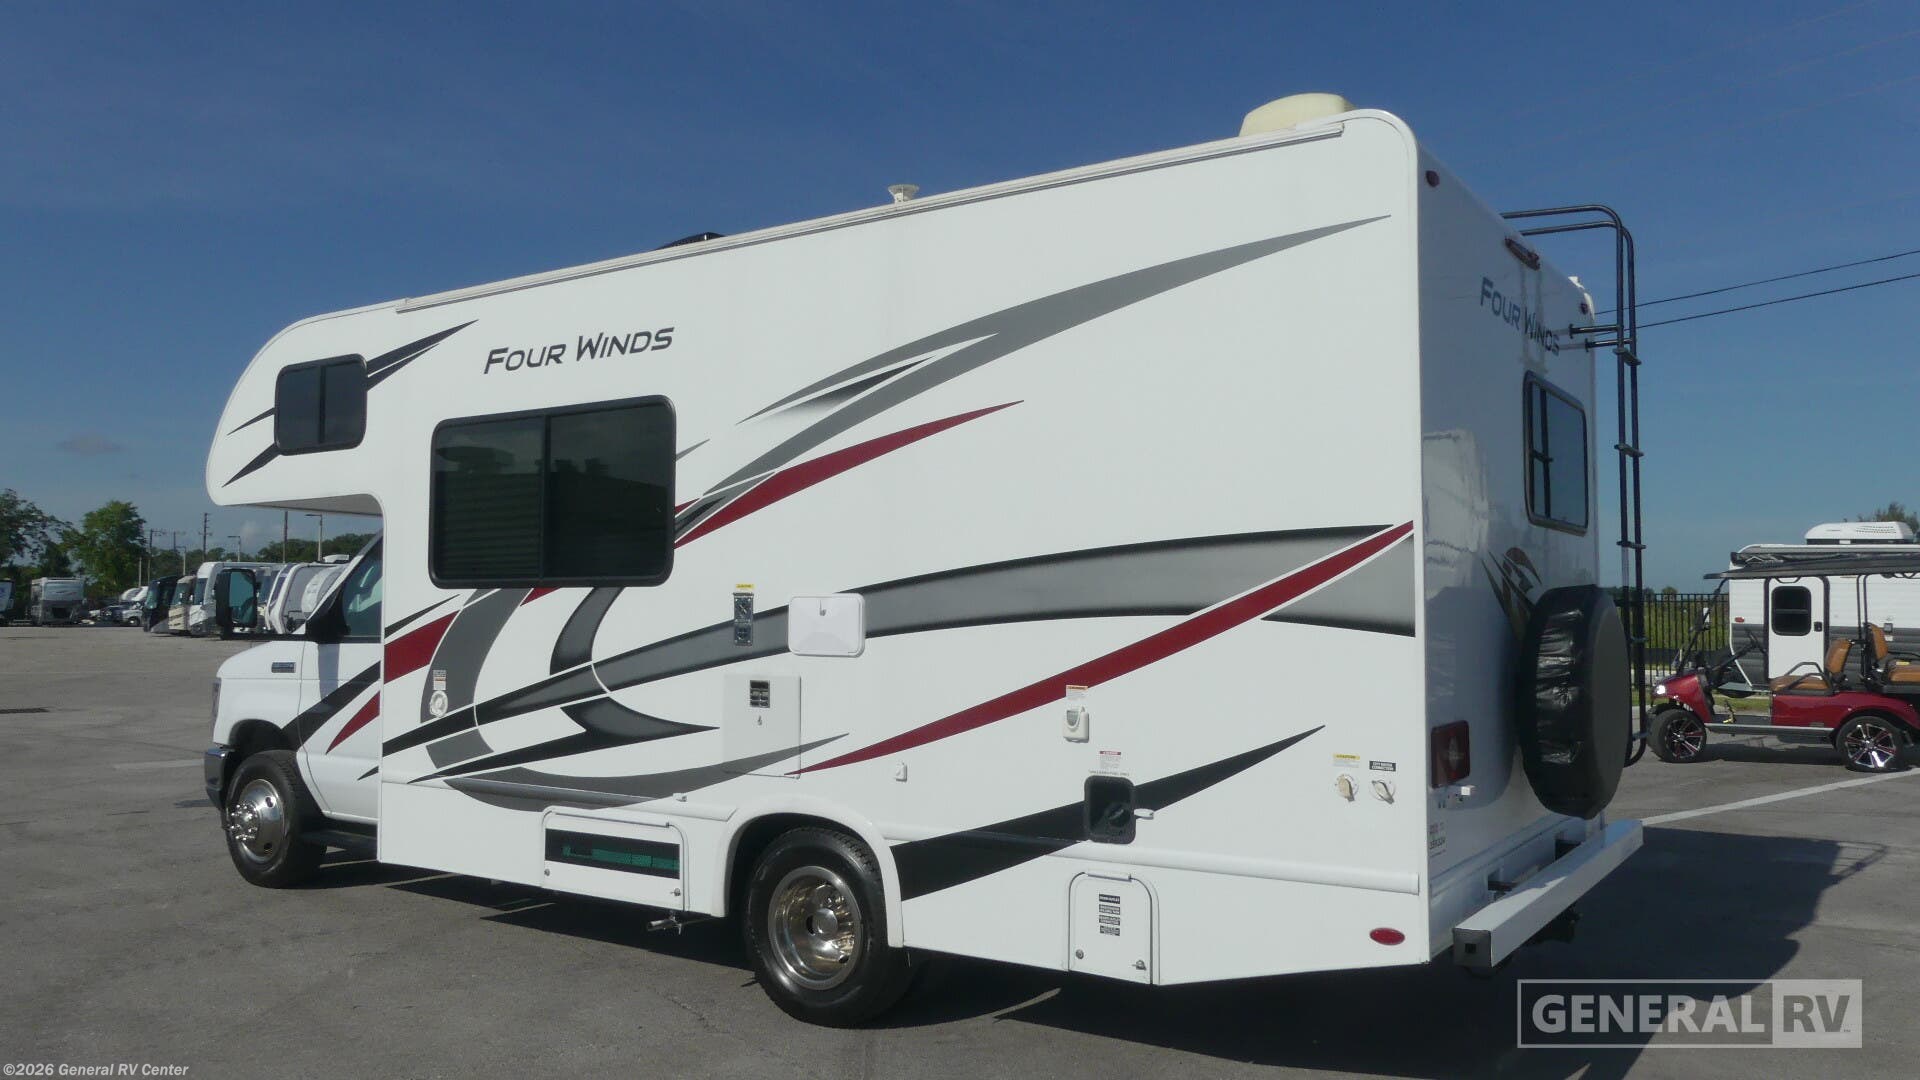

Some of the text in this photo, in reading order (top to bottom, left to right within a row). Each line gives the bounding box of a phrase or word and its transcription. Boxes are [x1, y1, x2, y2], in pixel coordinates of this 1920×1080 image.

[1480, 277, 1560, 356] FOUR WINDS
[484, 327, 675, 375] FOUR WINDS
